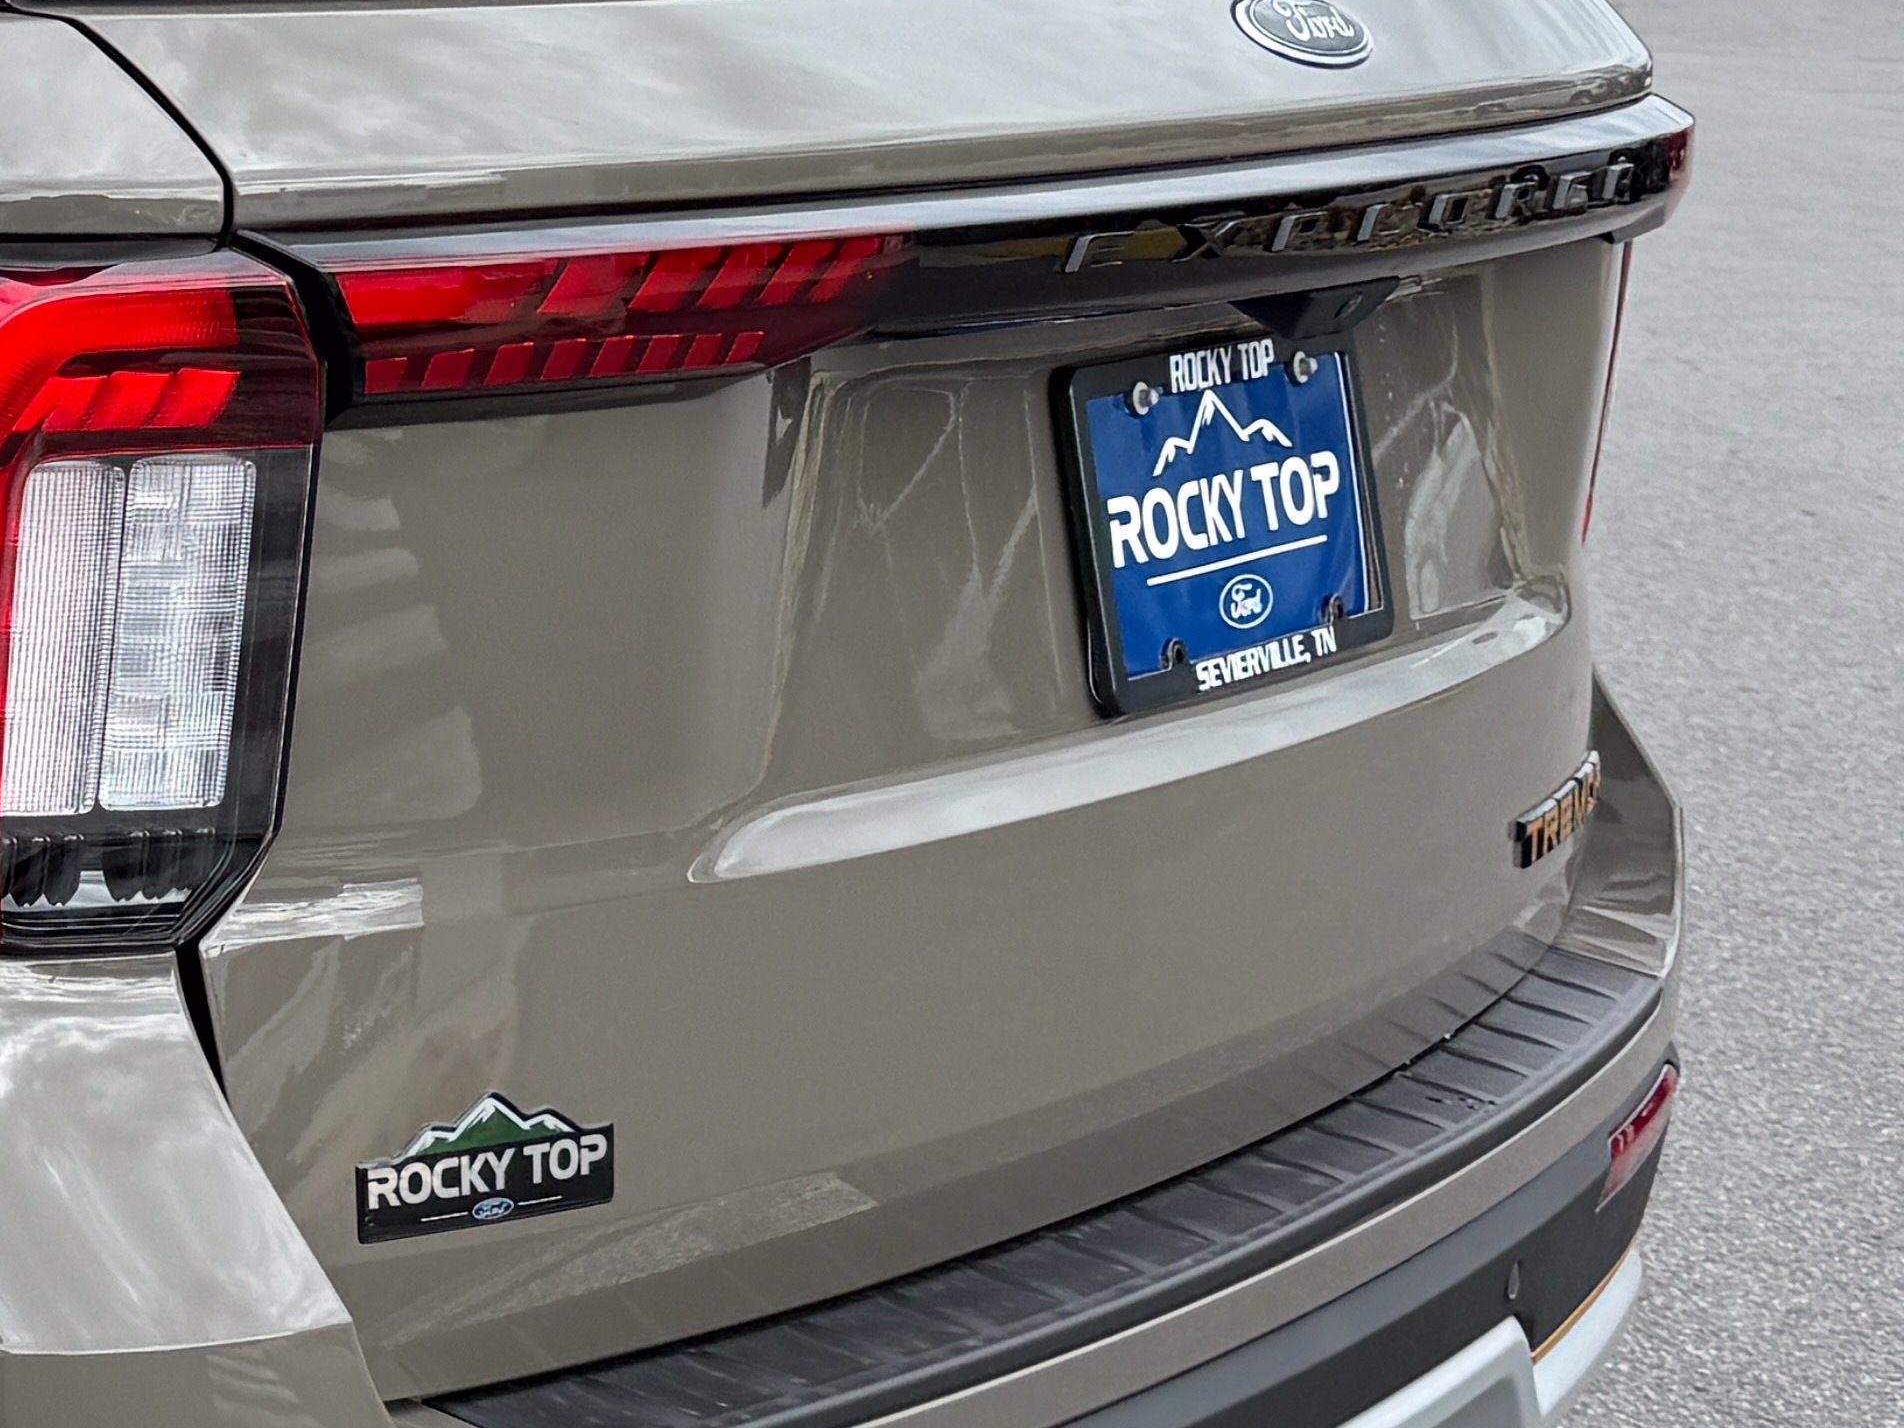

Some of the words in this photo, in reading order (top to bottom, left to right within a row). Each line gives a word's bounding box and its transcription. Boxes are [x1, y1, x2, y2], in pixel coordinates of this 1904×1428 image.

[1168, 346, 1233, 394] ROCKY
[1237, 338, 1276, 378] TOP
[1106, 468, 1245, 570] ROCKY
[1250, 450, 1341, 532] TOP
[1195, 635, 1312, 692] SEVIERVILLE,
[1311, 626, 1338, 656] TN
[367, 1147, 518, 1211] ROCKY
[523, 1133, 609, 1185] TOP
